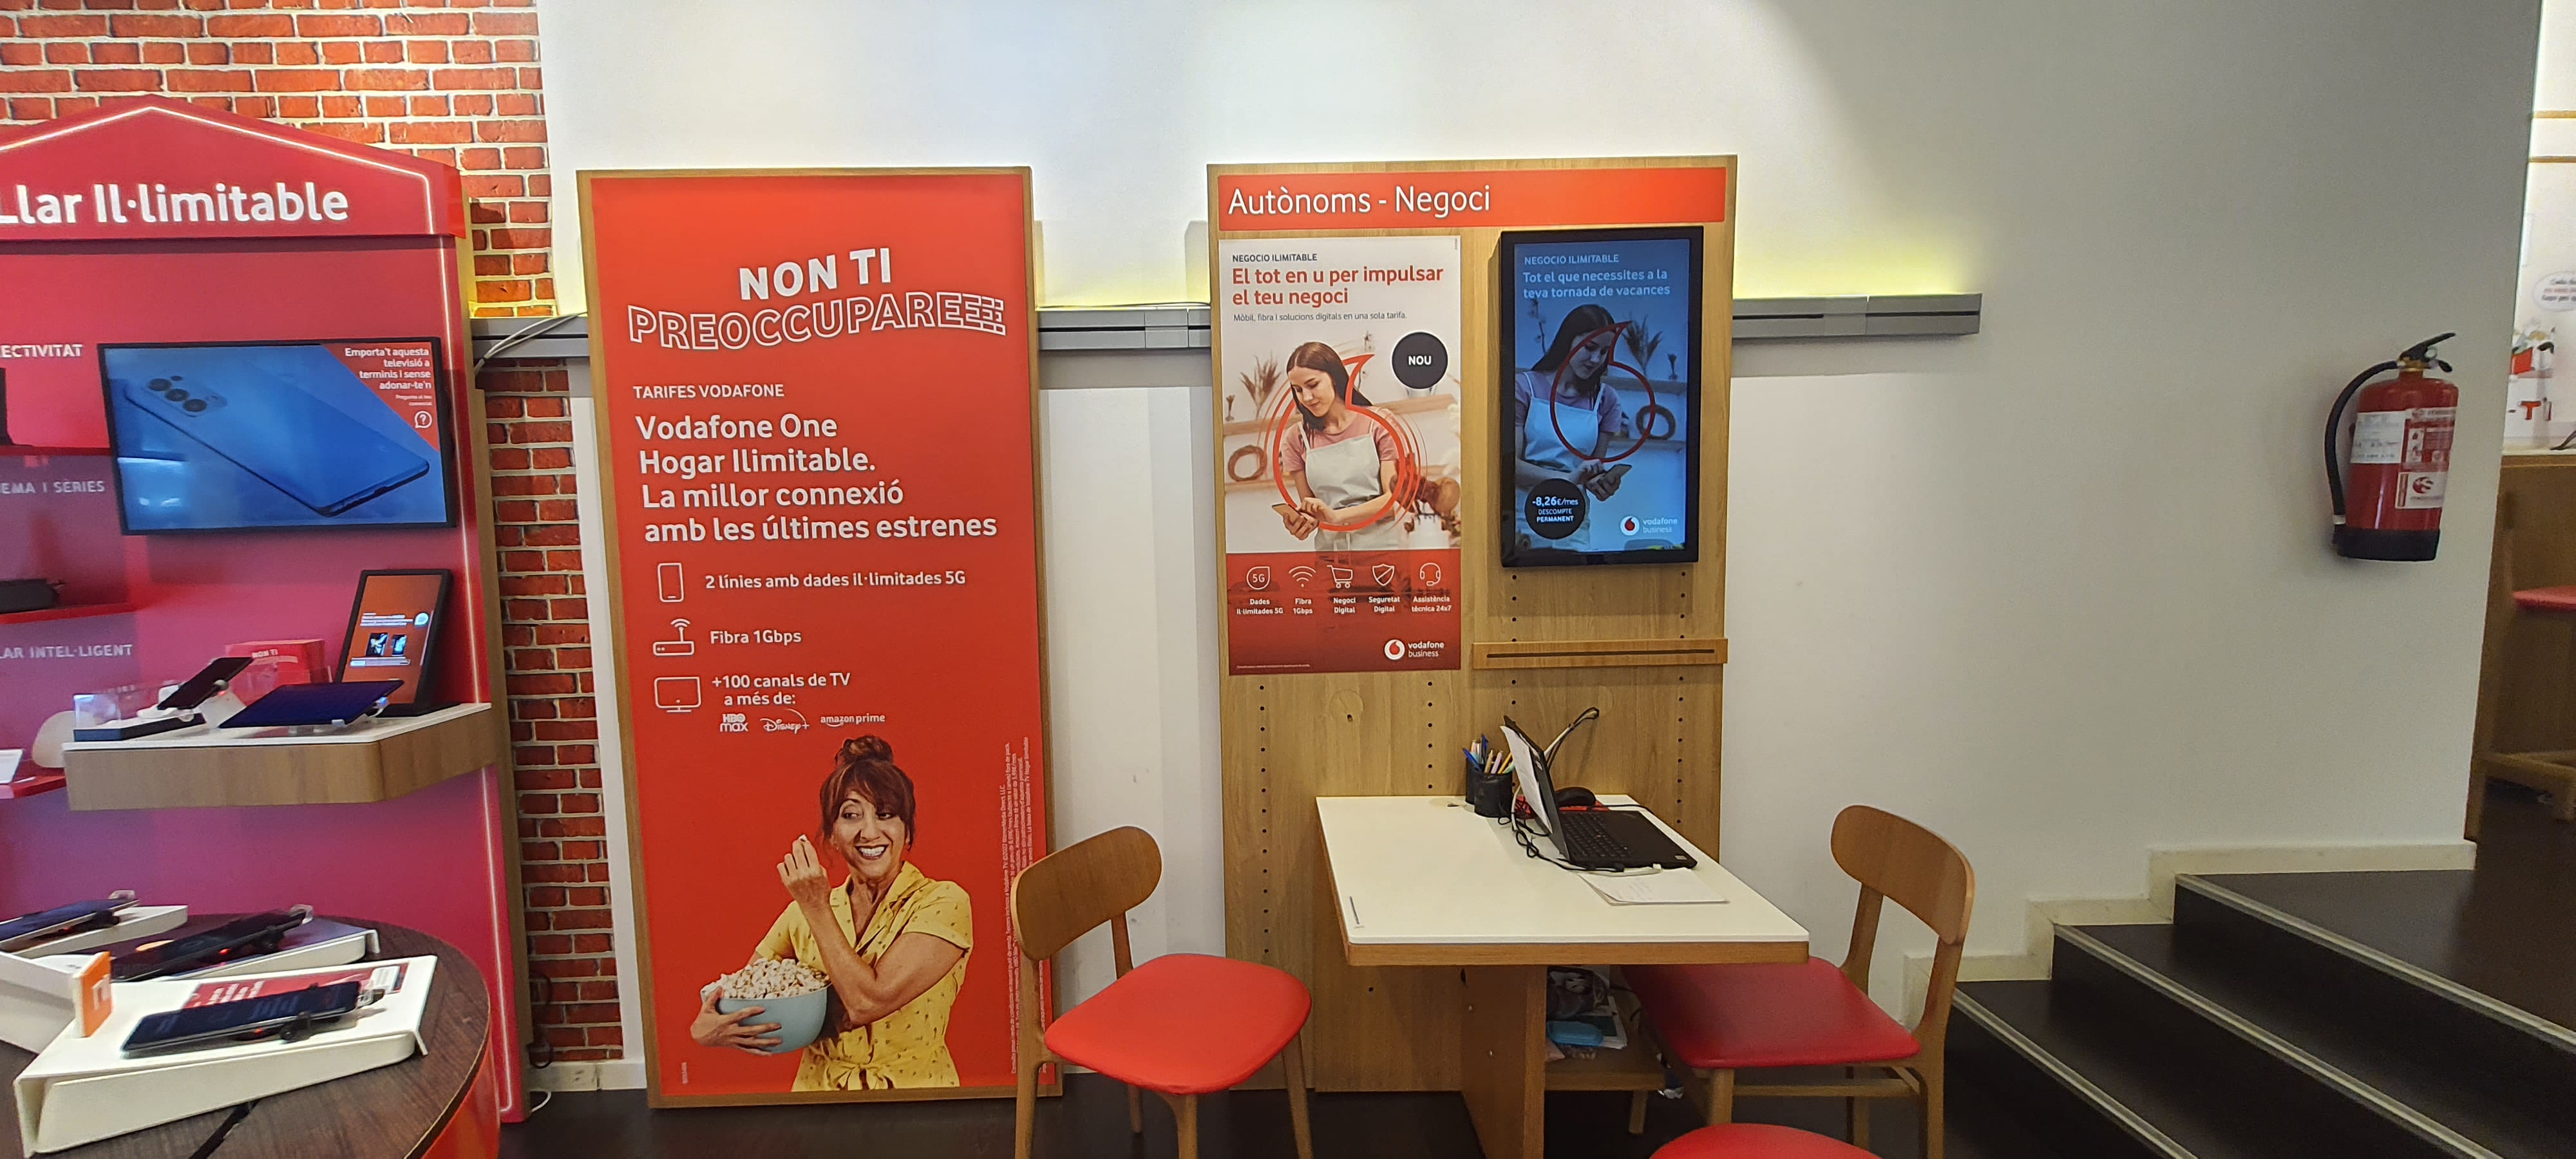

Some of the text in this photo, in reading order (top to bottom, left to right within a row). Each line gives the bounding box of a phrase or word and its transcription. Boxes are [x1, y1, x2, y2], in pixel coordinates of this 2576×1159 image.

[94, 182, 348, 223] Il·limitable
[1228, 186, 1371, 215] Autònoms
[1395, 185, 1491, 218] Negoci
[1233, 253, 1318, 263] NEGOCIO ILIMITABLE
[1524, 254, 1619, 265] NEGOCIO ILIMITABLE
[739, 247, 891, 300] NON TI
[1233, 265, 1444, 287] El tot en u per impulsar
[1523, 269, 1667, 285] Tot el que necessites a la
[1233, 288, 1349, 308] el teu negoci
[1523, 285, 1671, 298] teva tornada de vacances
[1257, 313, 1274, 321] fibra
[1279, 312, 1314, 321] solucions
[1315, 312, 1342, 322] digitals
[392, 348, 429, 357] aquesta
[384, 358, 422, 367] televisió
[1408, 355, 1432, 366] NOU
[359, 370, 398, 379] terminis
[633, 384, 784, 399] TARIFES VODAFONE
[635, 413, 837, 440] Vodafone One
[639, 448, 876, 480] Hogar Ilimitable.
[642, 478, 904, 508] La millor connexió
[644, 514, 998, 542] amb les últimes estrenes
[1643, 517, 1678, 525] vodafone
[705, 570, 966, 589] 2 línies amb dades il·limitades 5G
[1253, 574, 1265, 583] 5G
[1374, 605, 1396, 614] Digital
[710, 630, 802, 645] Fibra 1Gbps
[1408, 641, 1444, 649] vodafone
[1408, 650, 1439, 658] business
[712, 673, 851, 689] +100 canals de TV
[724, 692, 796, 706] a més de:
[723, 713, 745, 722] HBO
[820, 713, 886, 727] amazon prime
